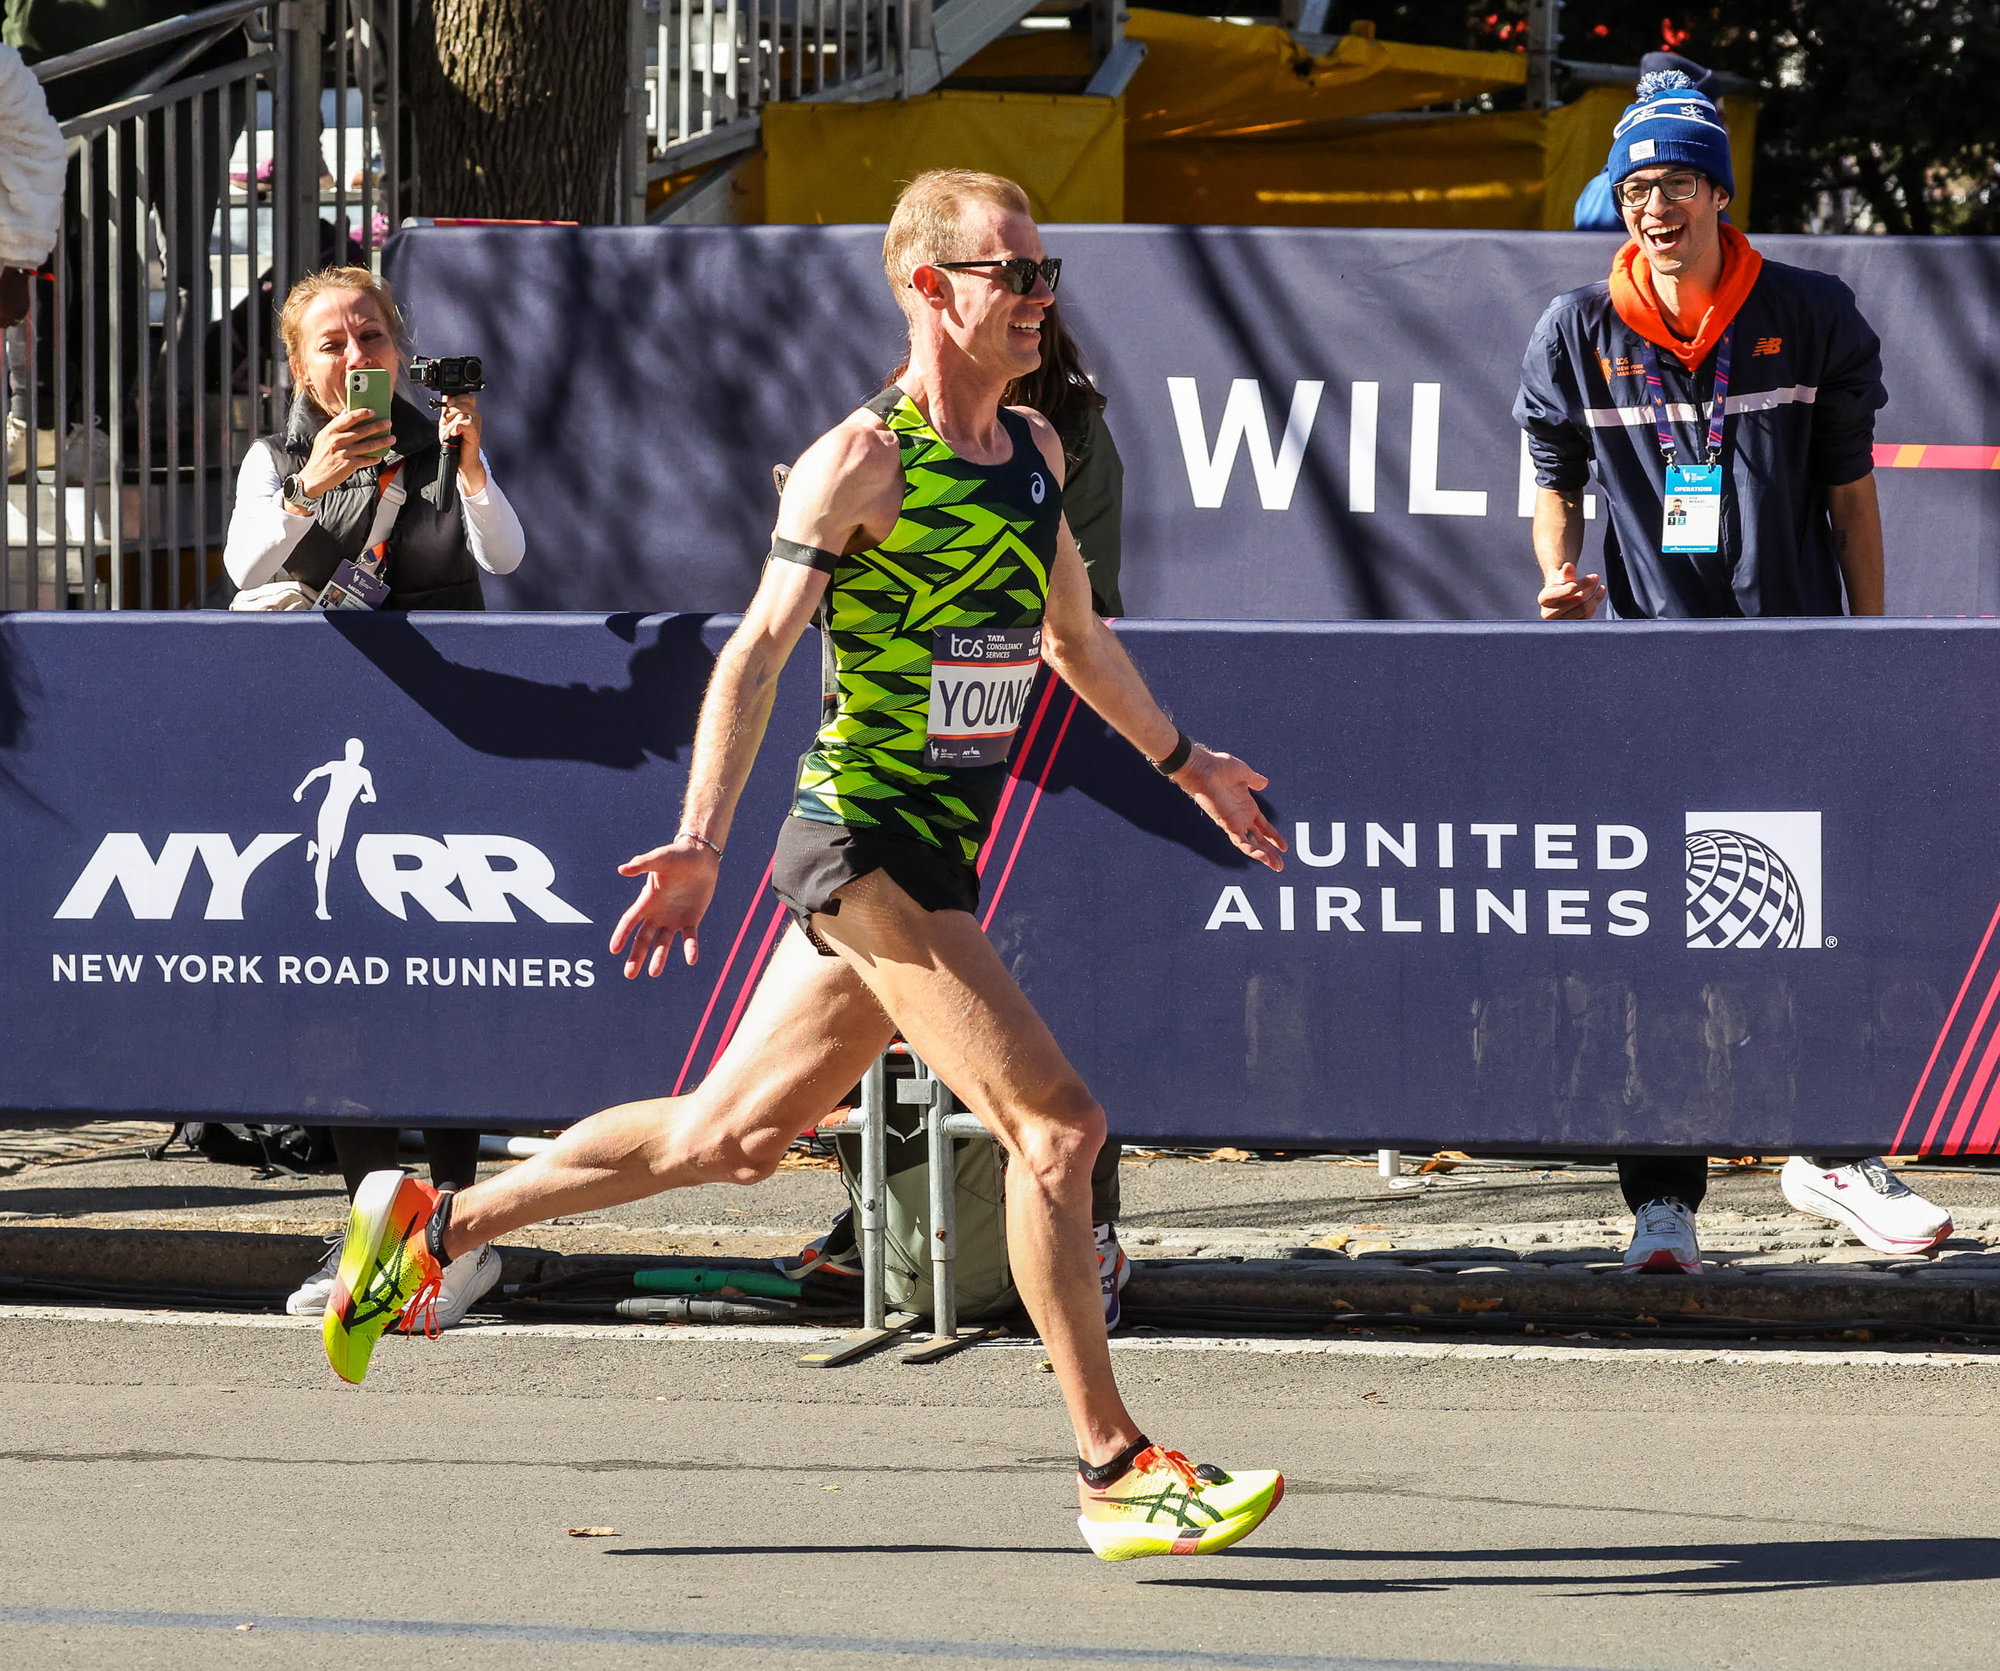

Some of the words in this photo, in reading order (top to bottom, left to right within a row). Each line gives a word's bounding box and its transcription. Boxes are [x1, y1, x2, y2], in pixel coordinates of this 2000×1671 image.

[347, 583, 366, 599] MEDIA
[951, 633, 984, 658] tcs
[986, 634, 1005, 642] TATA
[985, 651, 1010, 659] SERVICES
[986, 643, 1023, 651] CONSULTANCY
[1296, 822, 1649, 870] UNITED
[1205, 886, 1650, 936] AIRLINES
[52, 954, 144, 983] NEW
[155, 955, 264, 984] YORK
[278, 957, 389, 986] ROAD
[406, 958, 596, 988] RUNNERS
[1109, 1503, 1132, 1511] TOKYO
